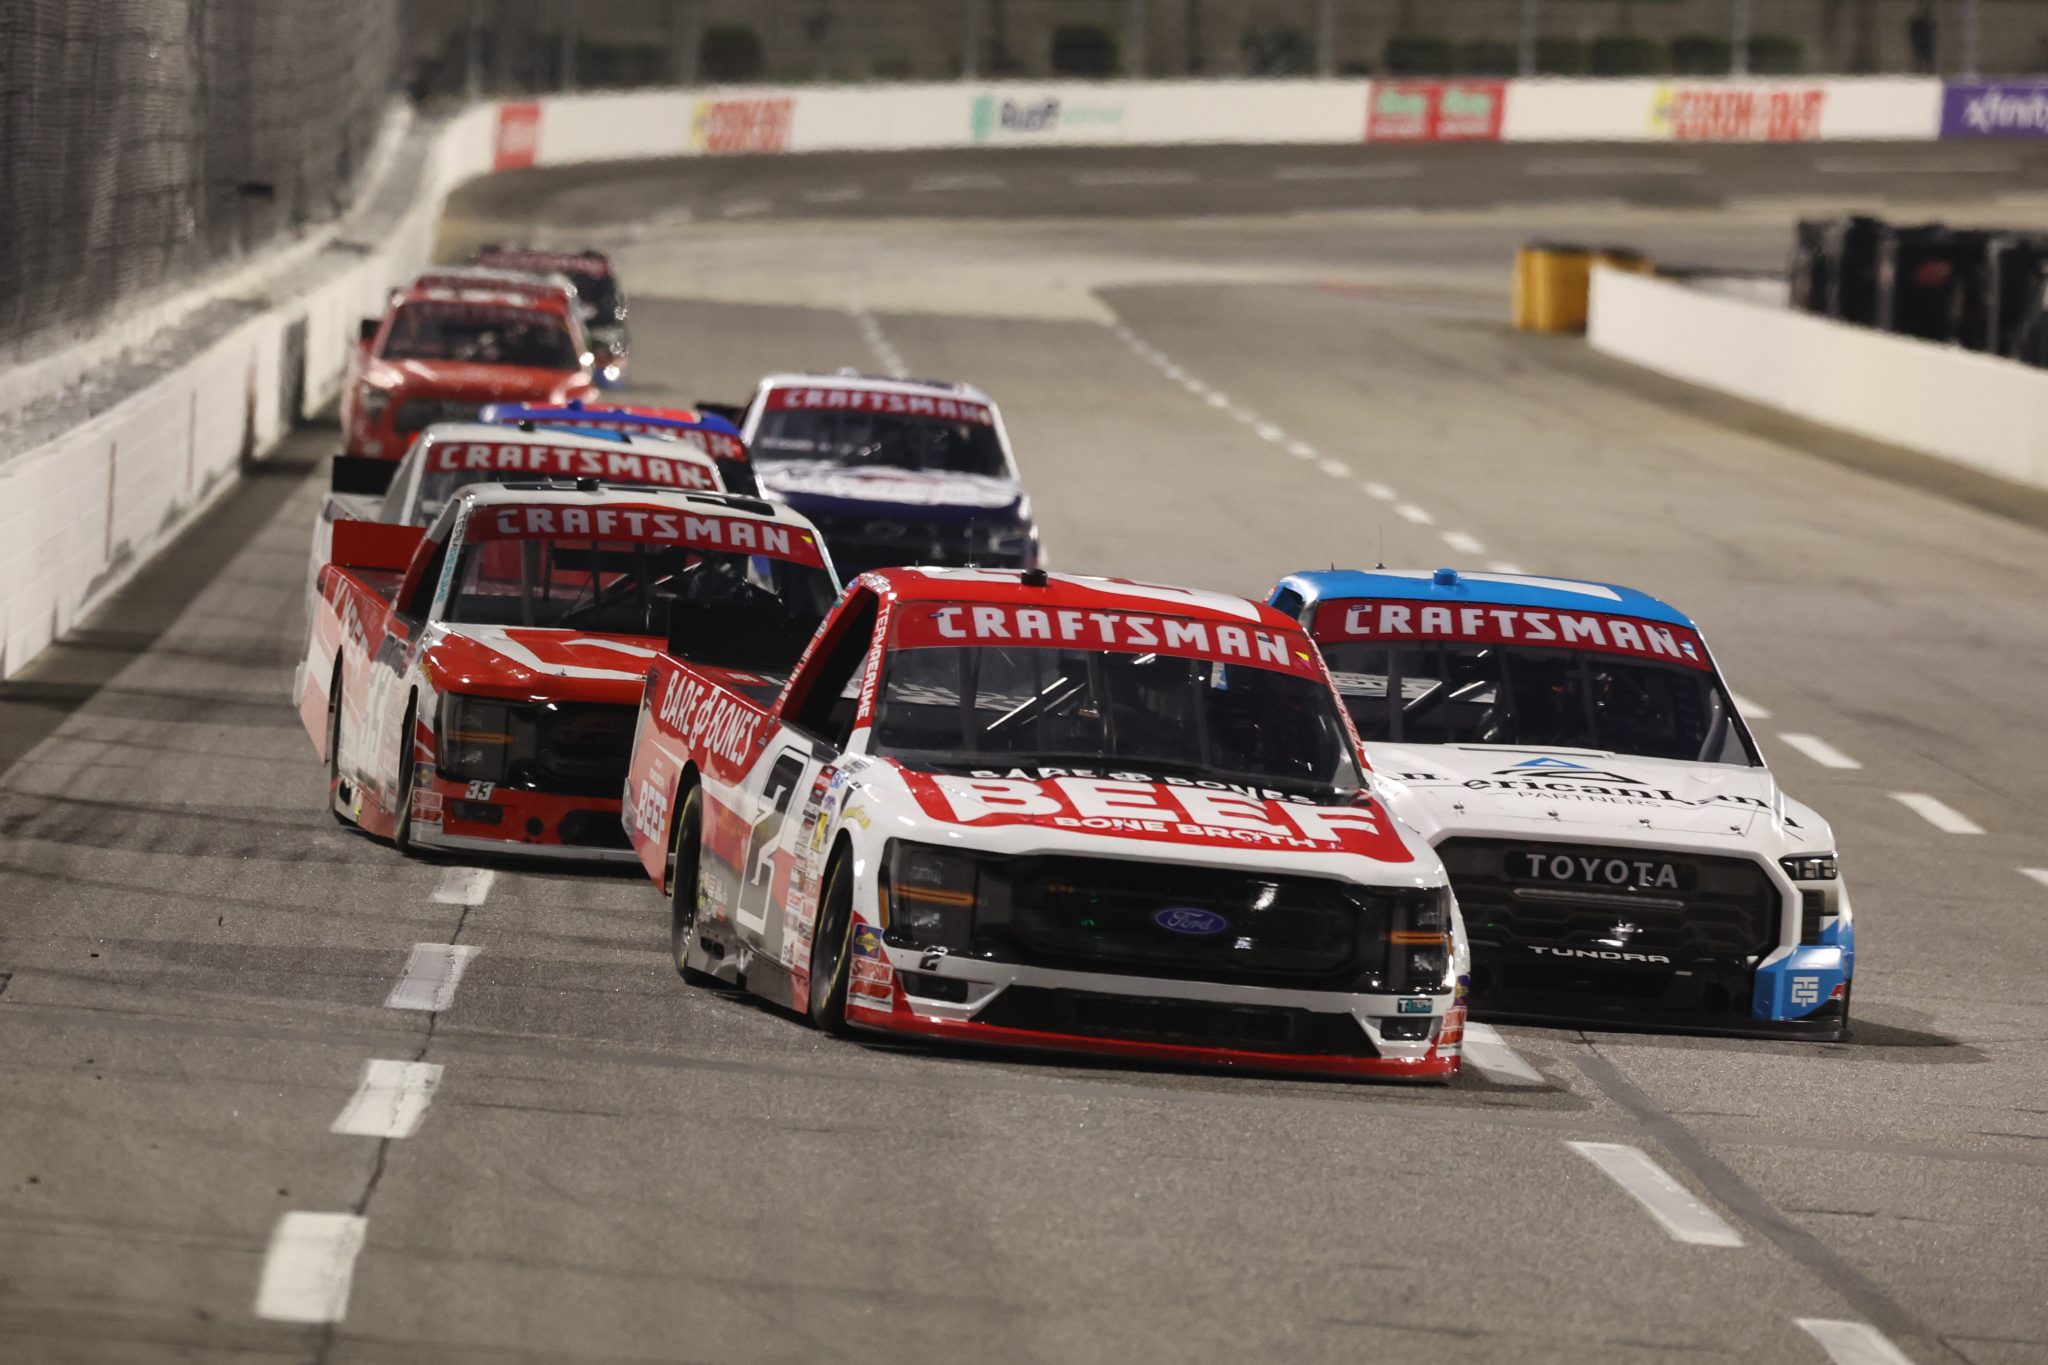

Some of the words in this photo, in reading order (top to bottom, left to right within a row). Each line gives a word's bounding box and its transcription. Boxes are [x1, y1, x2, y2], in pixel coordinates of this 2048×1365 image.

[784, 388, 981, 421] CRAFTSMAN
[439, 447, 702, 488] CRAFTSMAN
[496, 508, 791, 555] CRAFTSMAN
[936, 606, 1291, 666] CRAFTSMAN
[1344, 603, 1680, 658] CRAFTSMAN
[857, 604, 891, 720] TEAMREAUME
[659, 669, 705, 736] BARE
[702, 698, 762, 767] BONES
[465, 779, 496, 801] 33
[970, 767, 1098, 782] BARE
[1164, 776, 1317, 805] BONES
[1517, 791, 1662, 808] PARTNERS
[636, 779, 668, 847] BEEF
[930, 774, 1380, 843] BEEF
[737, 745, 812, 935] 2
[1053, 816, 1169, 833] BONE
[1175, 822, 1317, 849] BROTH
[1526, 854, 1679, 888] TOYOTA
[1167, 910, 1214, 931] Ford
[919, 945, 949, 973] 2
[1527, 945, 1671, 964] TUNDRA
